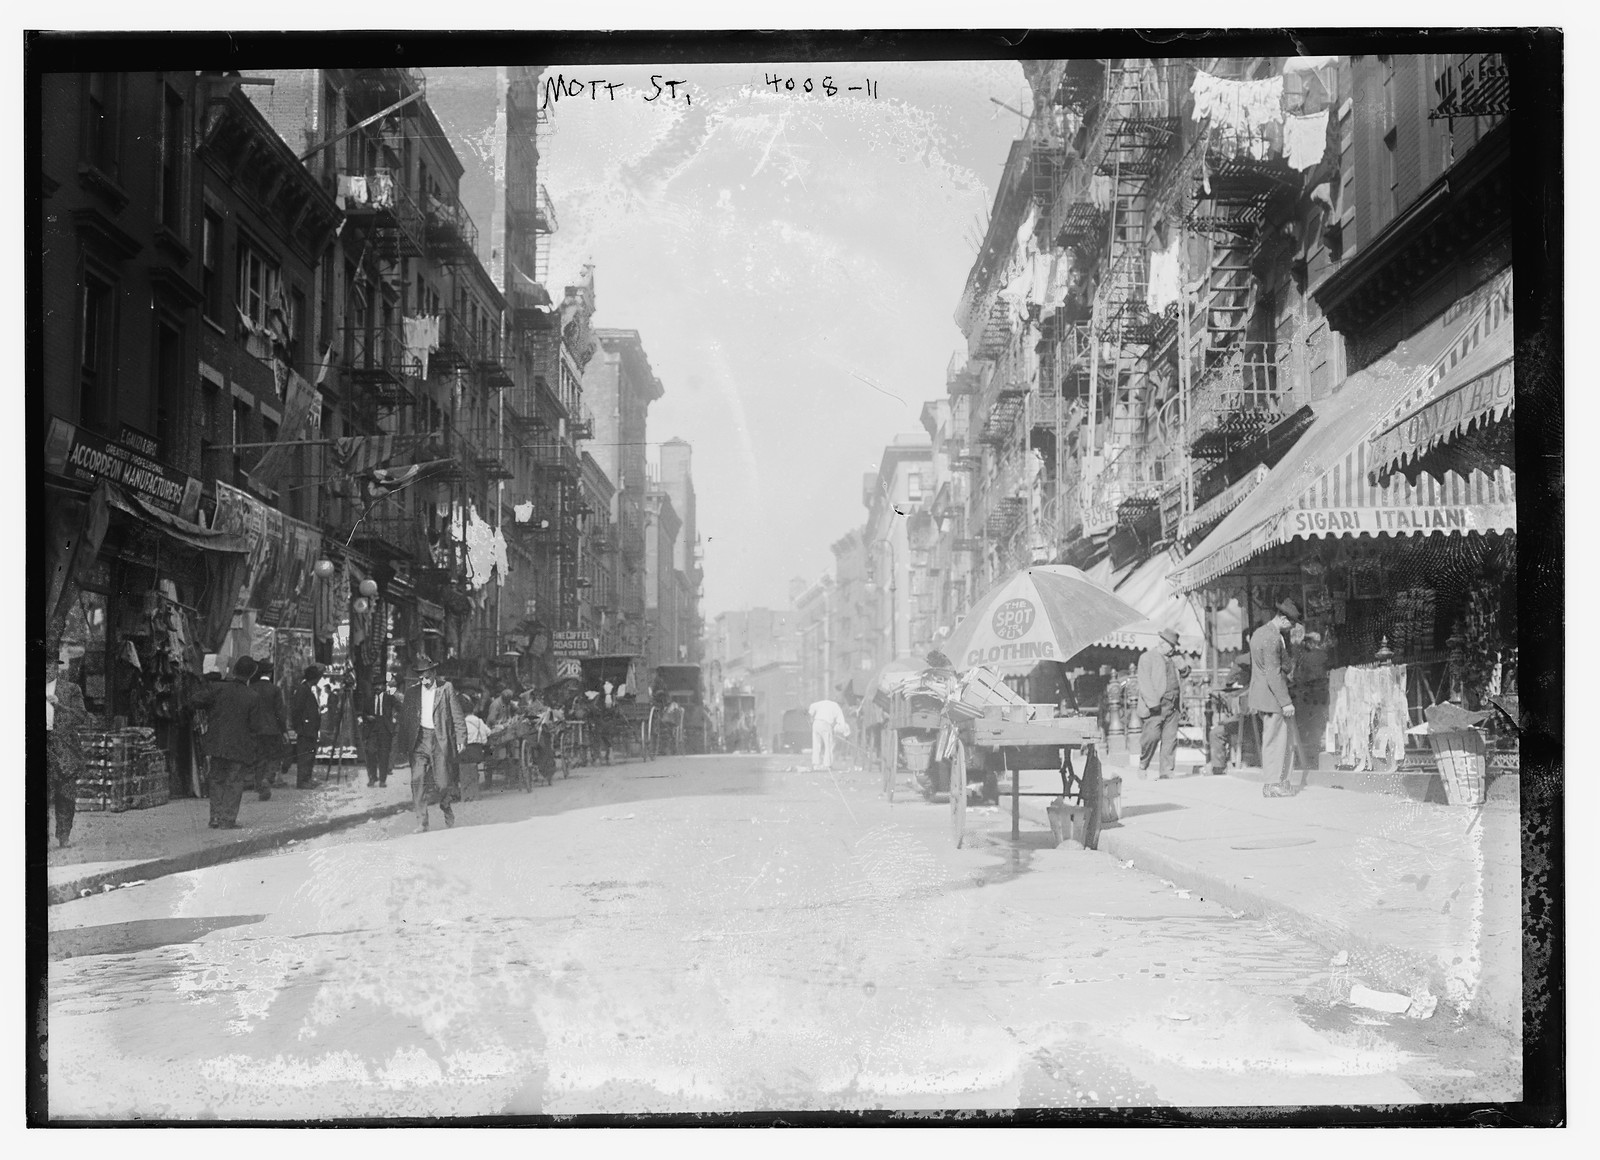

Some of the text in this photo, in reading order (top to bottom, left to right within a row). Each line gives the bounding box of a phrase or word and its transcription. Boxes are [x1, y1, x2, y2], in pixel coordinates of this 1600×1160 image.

[69, 442, 124, 481] ACCORDEON
[122, 463, 184, 505] MANUFACTURERS
[1083, 501, 1112, 519] STORE
[1084, 510, 1116, 528] TO-LET
[1295, 508, 1467, 531] SIGARI ITALIANI
[1004, 600, 1027, 609] THE
[996, 608, 1033, 627] SPOT
[997, 625, 1024, 639] BUY
[553, 640, 588, 649] ROASTED
[967, 641, 1055, 667] CLOTHING
